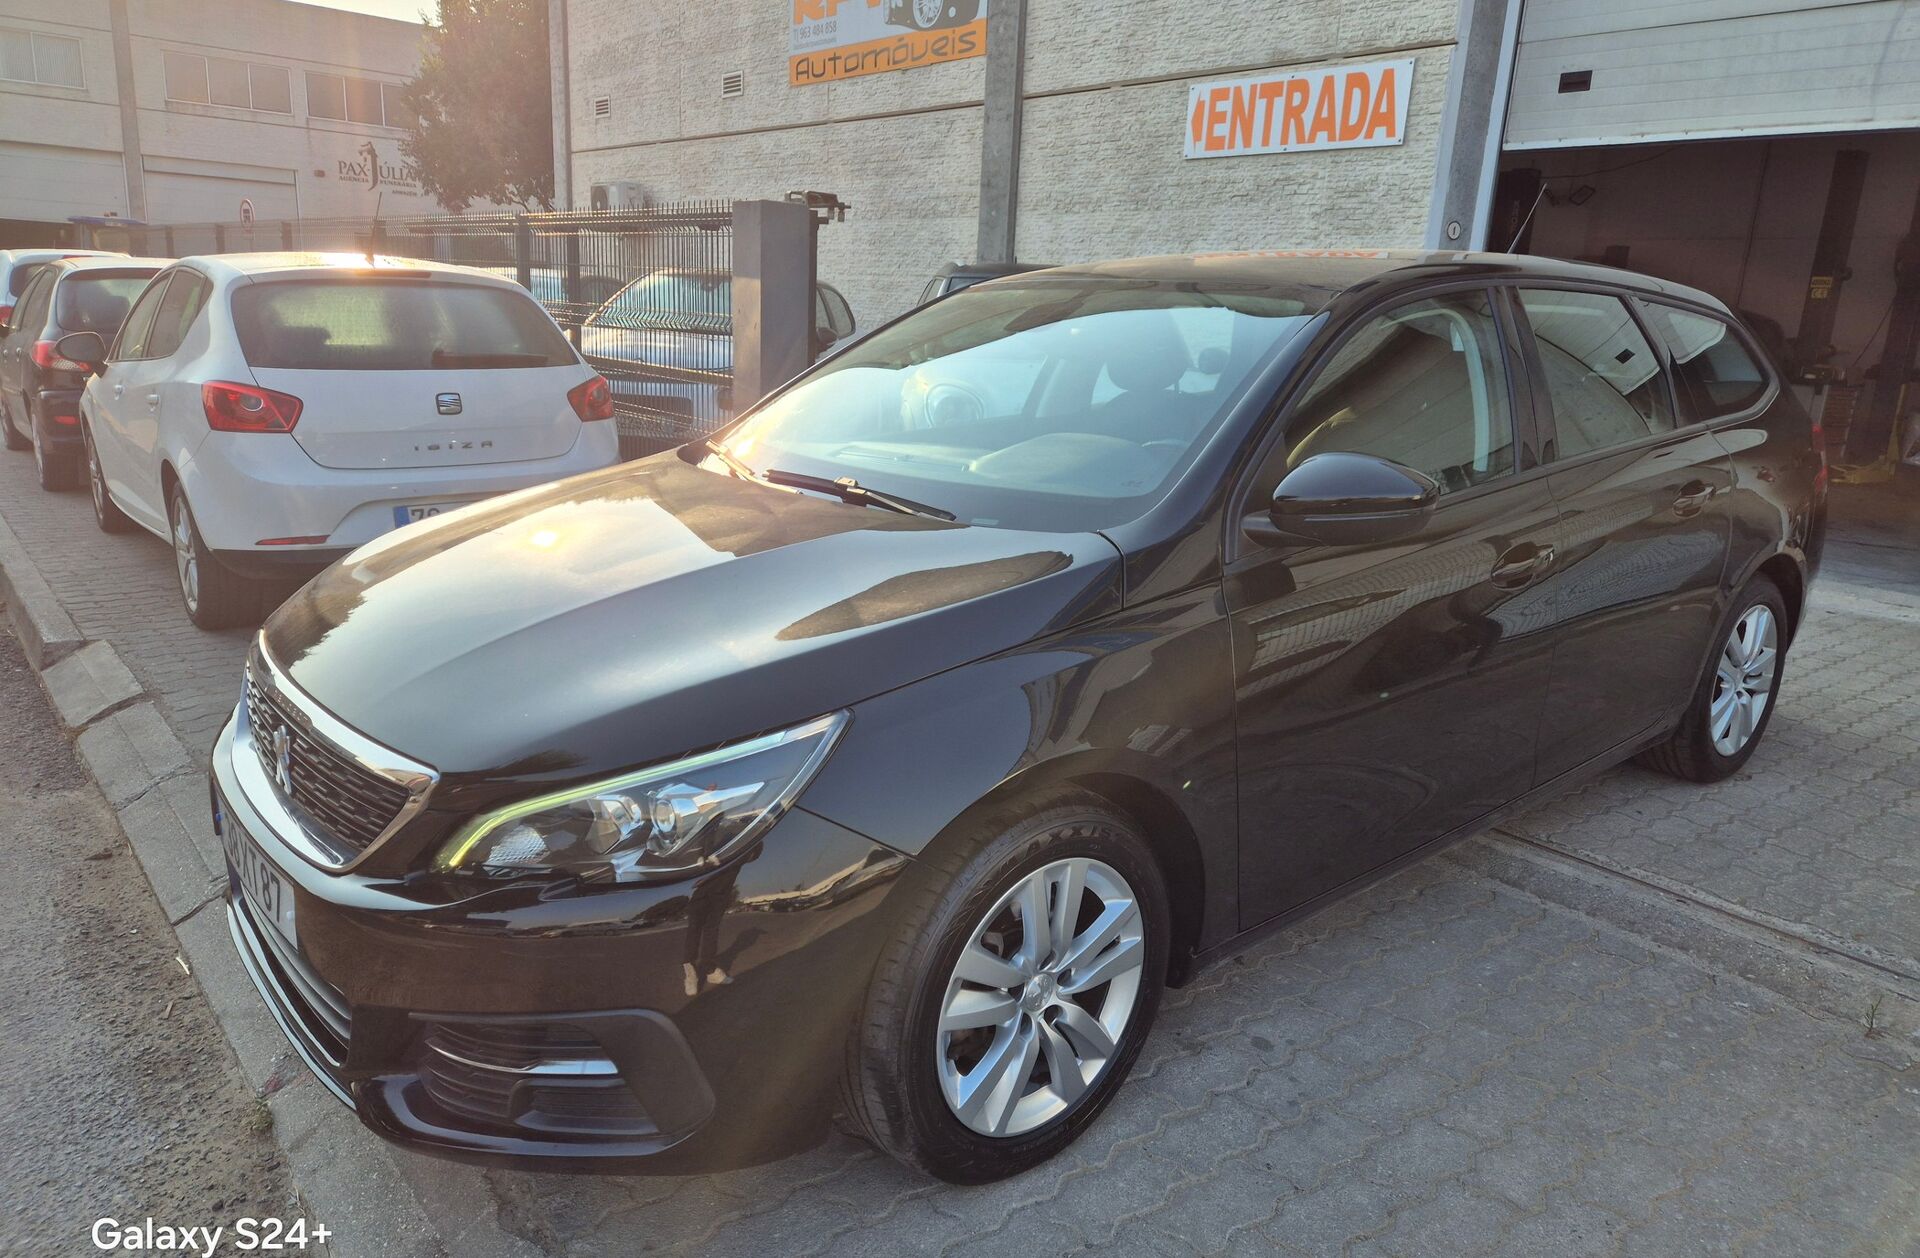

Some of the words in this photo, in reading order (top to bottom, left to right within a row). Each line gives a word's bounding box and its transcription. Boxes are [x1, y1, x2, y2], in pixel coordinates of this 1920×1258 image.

[795, 30, 977, 81] Automóveis
[1204, 68, 1396, 151] ENTRADA
[338, 160, 368, 177] PAX
[414, 440, 493, 451] IBIZA
[260, 862, 281, 924] 87
